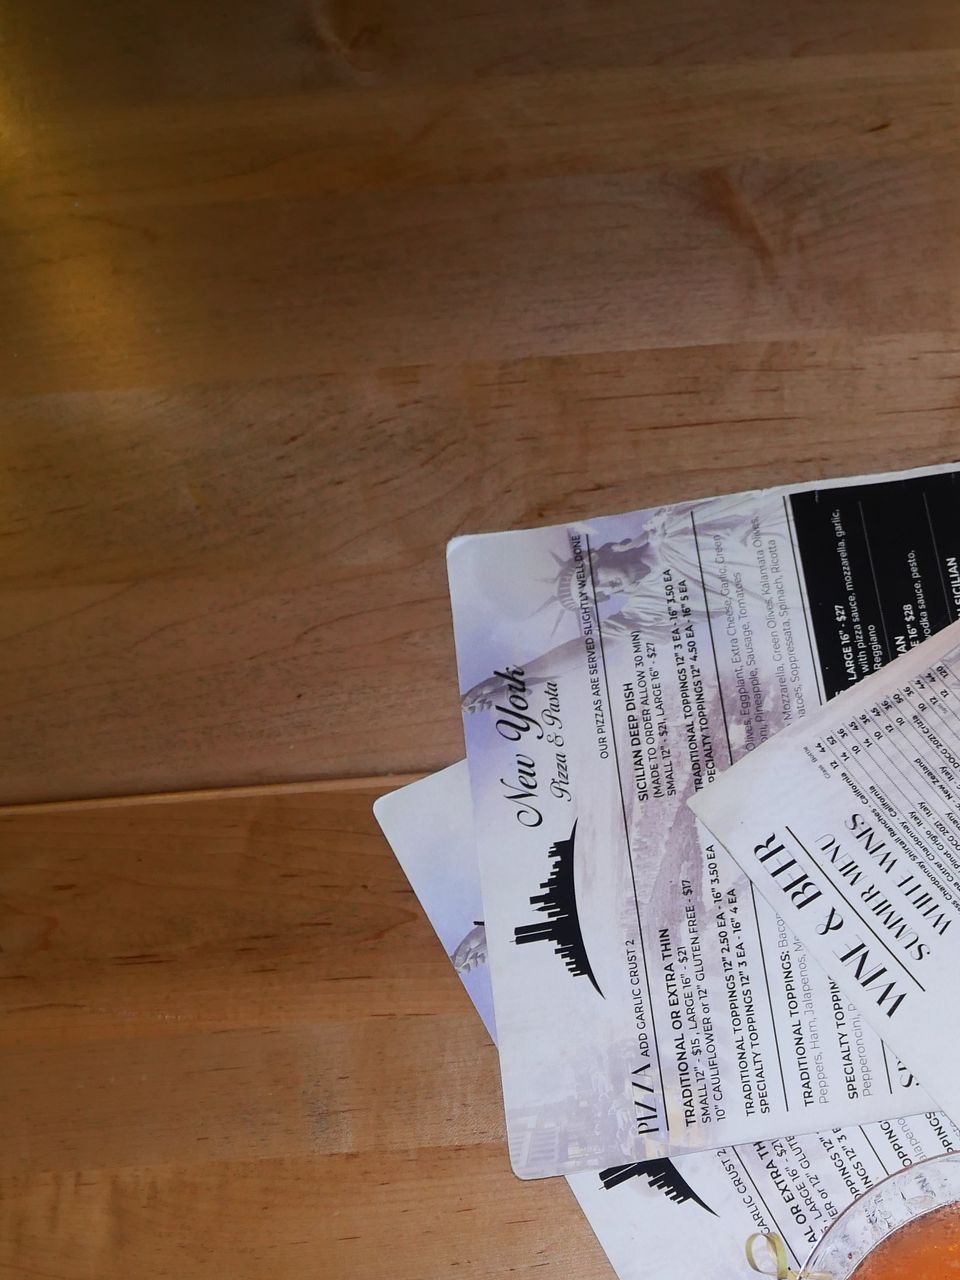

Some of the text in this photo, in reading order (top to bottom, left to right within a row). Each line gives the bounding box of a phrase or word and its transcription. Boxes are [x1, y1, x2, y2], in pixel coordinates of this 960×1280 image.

[570, 534, 609, 760] OUR PIZZAS ARE SERVED SLIGHTLY WELL DONE
[831, 508, 870, 674] with pizza sauce, mozzarella, garlic,
[833, 604, 858, 681] LARGE $27
[487, 661, 544, 828] New York
[535, 680, 572, 802] Pizza & Pasta
[622, 681, 649, 802] SICILIAN DEEP DISH
[629, 629, 666, 799] (MADE TO ORDER ALLOW 30 MIN)
[645, 641, 677, 797] SMALL $21, LARGE $27
[840, 771, 869, 805] California
[870, 807, 898, 838] Ranches
[749, 830, 910, 1018] WINE & BEER
[820, 837, 930, 961] SUMMER MENU
[848, 813, 952, 936] WHITE WINES
[915, 860, 953, 901] Chardonnay
[624, 938, 651, 1058] ADD GARLIC CRUST 2
[657, 927, 697, 1128] TRADITIONAL OR EXTRA THIN
[676, 945, 712, 1124] SMALL $15 LARGE $21
[680, 879, 723, 1102] CAULIFLOWER or GLUTEN FREE $17
[704, 843, 756, 1117] TRADITIONAL TOPPINGS 2.50 EA 3.50 EA
[779, 949, 815, 1108] TRADITIONAL TOPPINGS:
[631, 1062, 660, 1135] PIZZA
[716, 1147, 771, 1237] GARLIC CRUST 2
